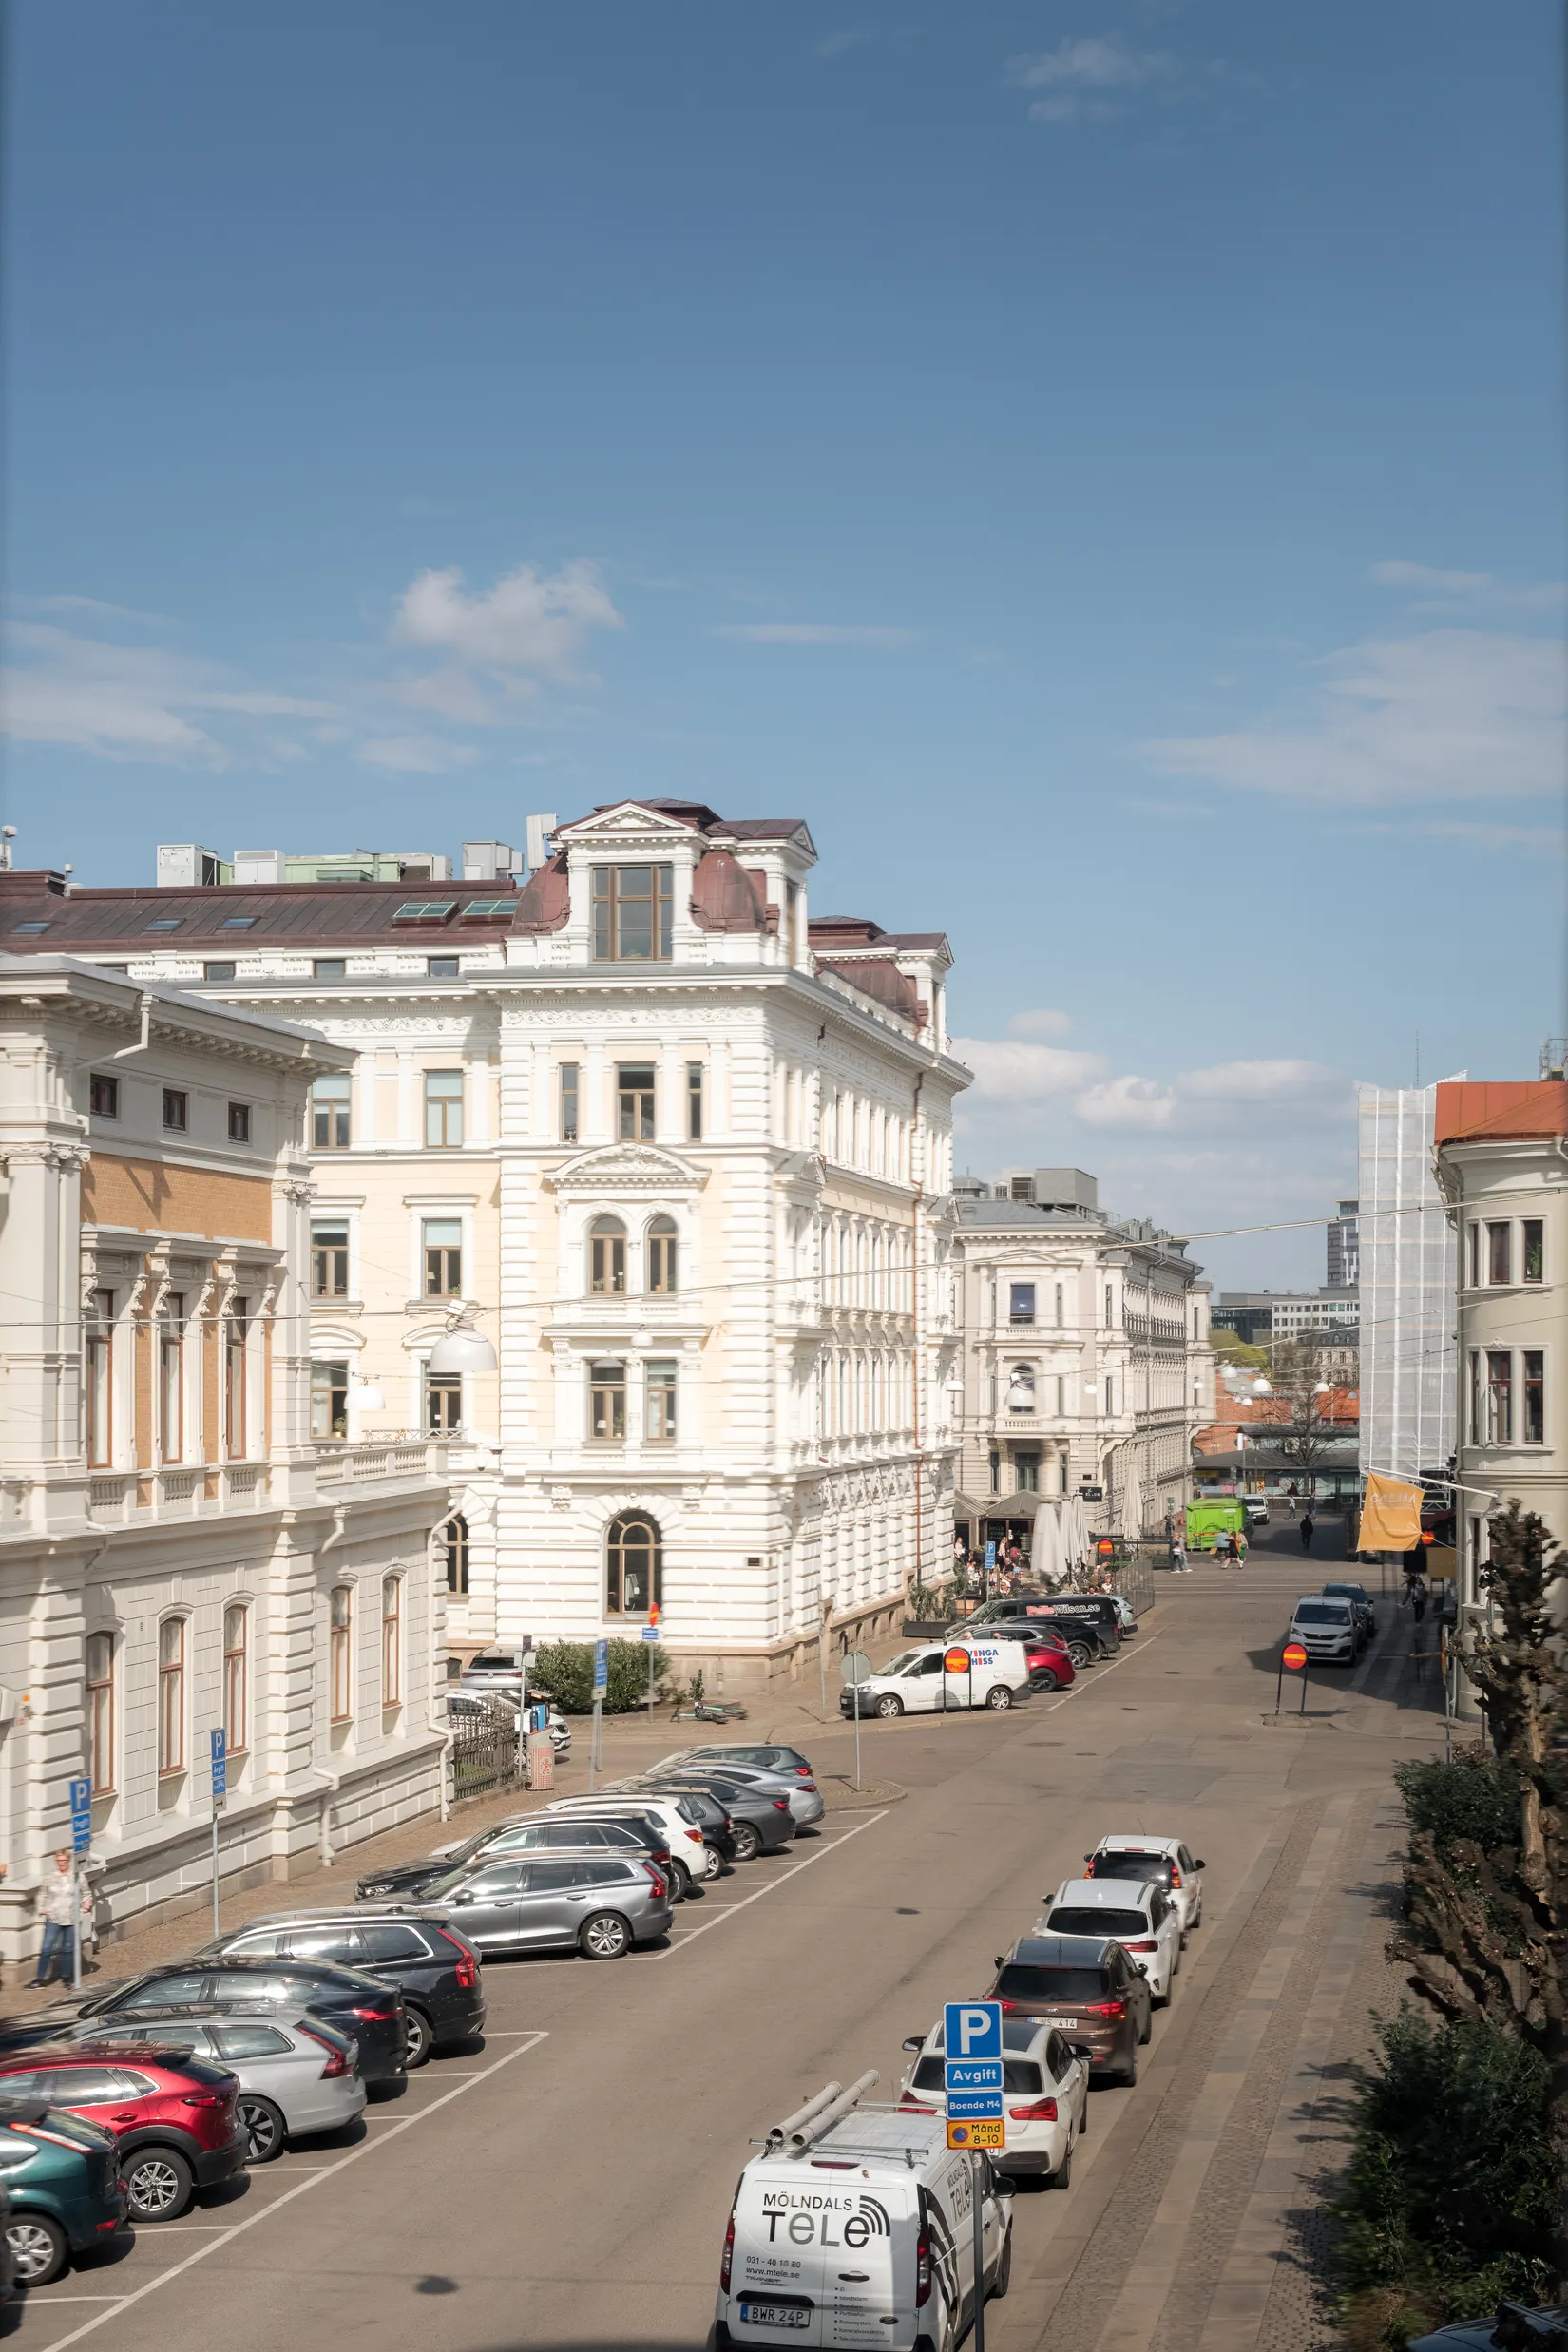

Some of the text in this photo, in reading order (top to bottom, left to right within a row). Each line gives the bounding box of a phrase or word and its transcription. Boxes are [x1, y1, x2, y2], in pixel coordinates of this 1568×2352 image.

[968, 1649, 999, 1657] VINGA
[216, 1732, 222, 1757] P
[77, 1783, 87, 1809] P
[960, 2009, 991, 2054] P
[953, 2069, 997, 2082] Avgift
[949, 2101, 984, 2110] Boende
[971, 2124, 1000, 2132] Månd
[973, 2134, 999, 2144] 8-10
[763, 2191, 852, 2211] MÖLNDALS
[746, 2267, 800, 2278] www.mtele.se
[752, 2307, 804, 2323] BWR 24P
